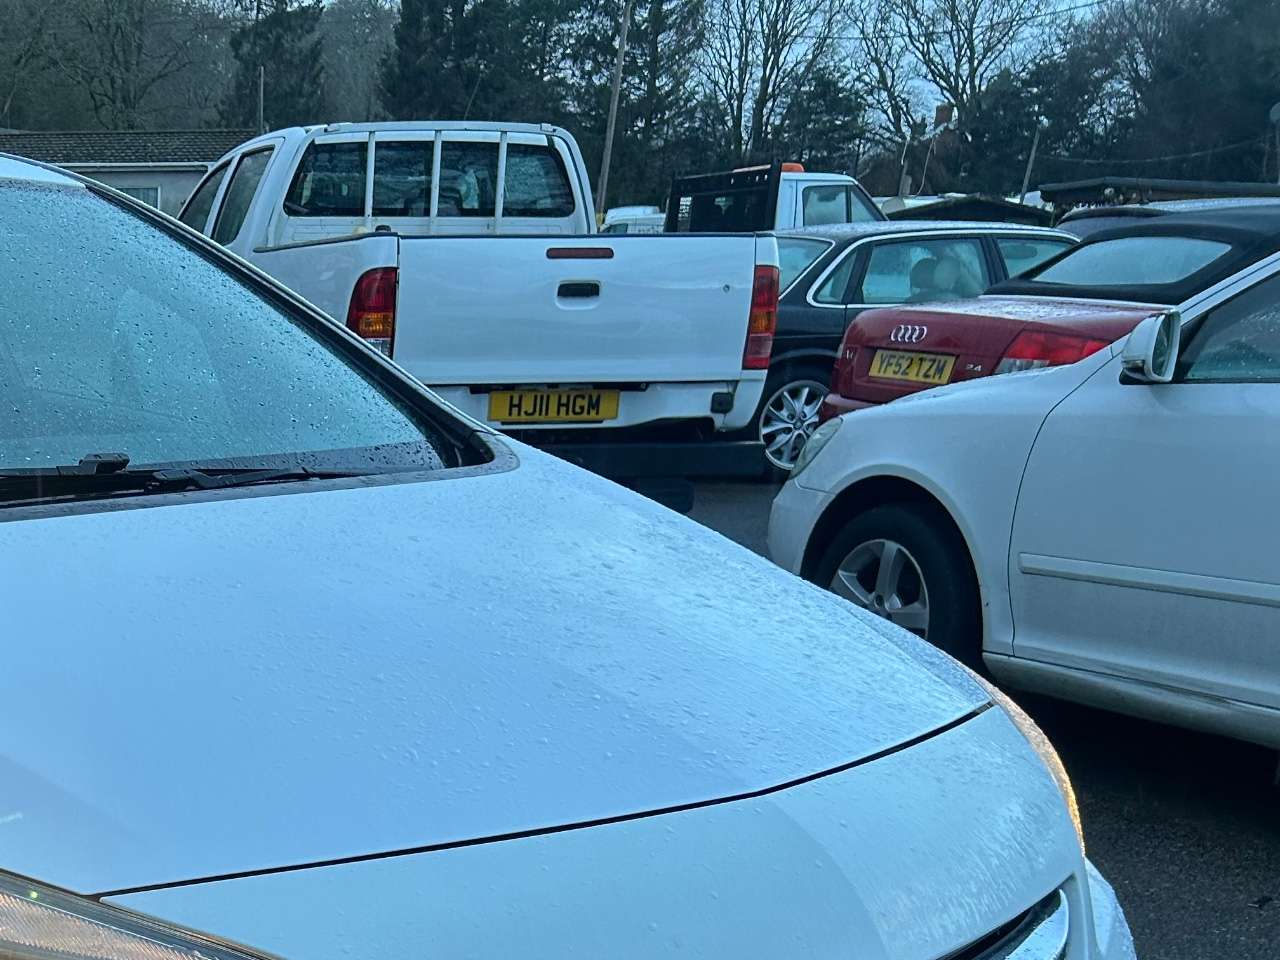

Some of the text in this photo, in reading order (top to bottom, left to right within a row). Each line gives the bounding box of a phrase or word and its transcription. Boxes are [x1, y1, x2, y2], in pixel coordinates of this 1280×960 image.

[878, 353, 914, 376] YF52
[914, 356, 948, 380] TZM
[508, 394, 601, 417] HJ11 HGM
